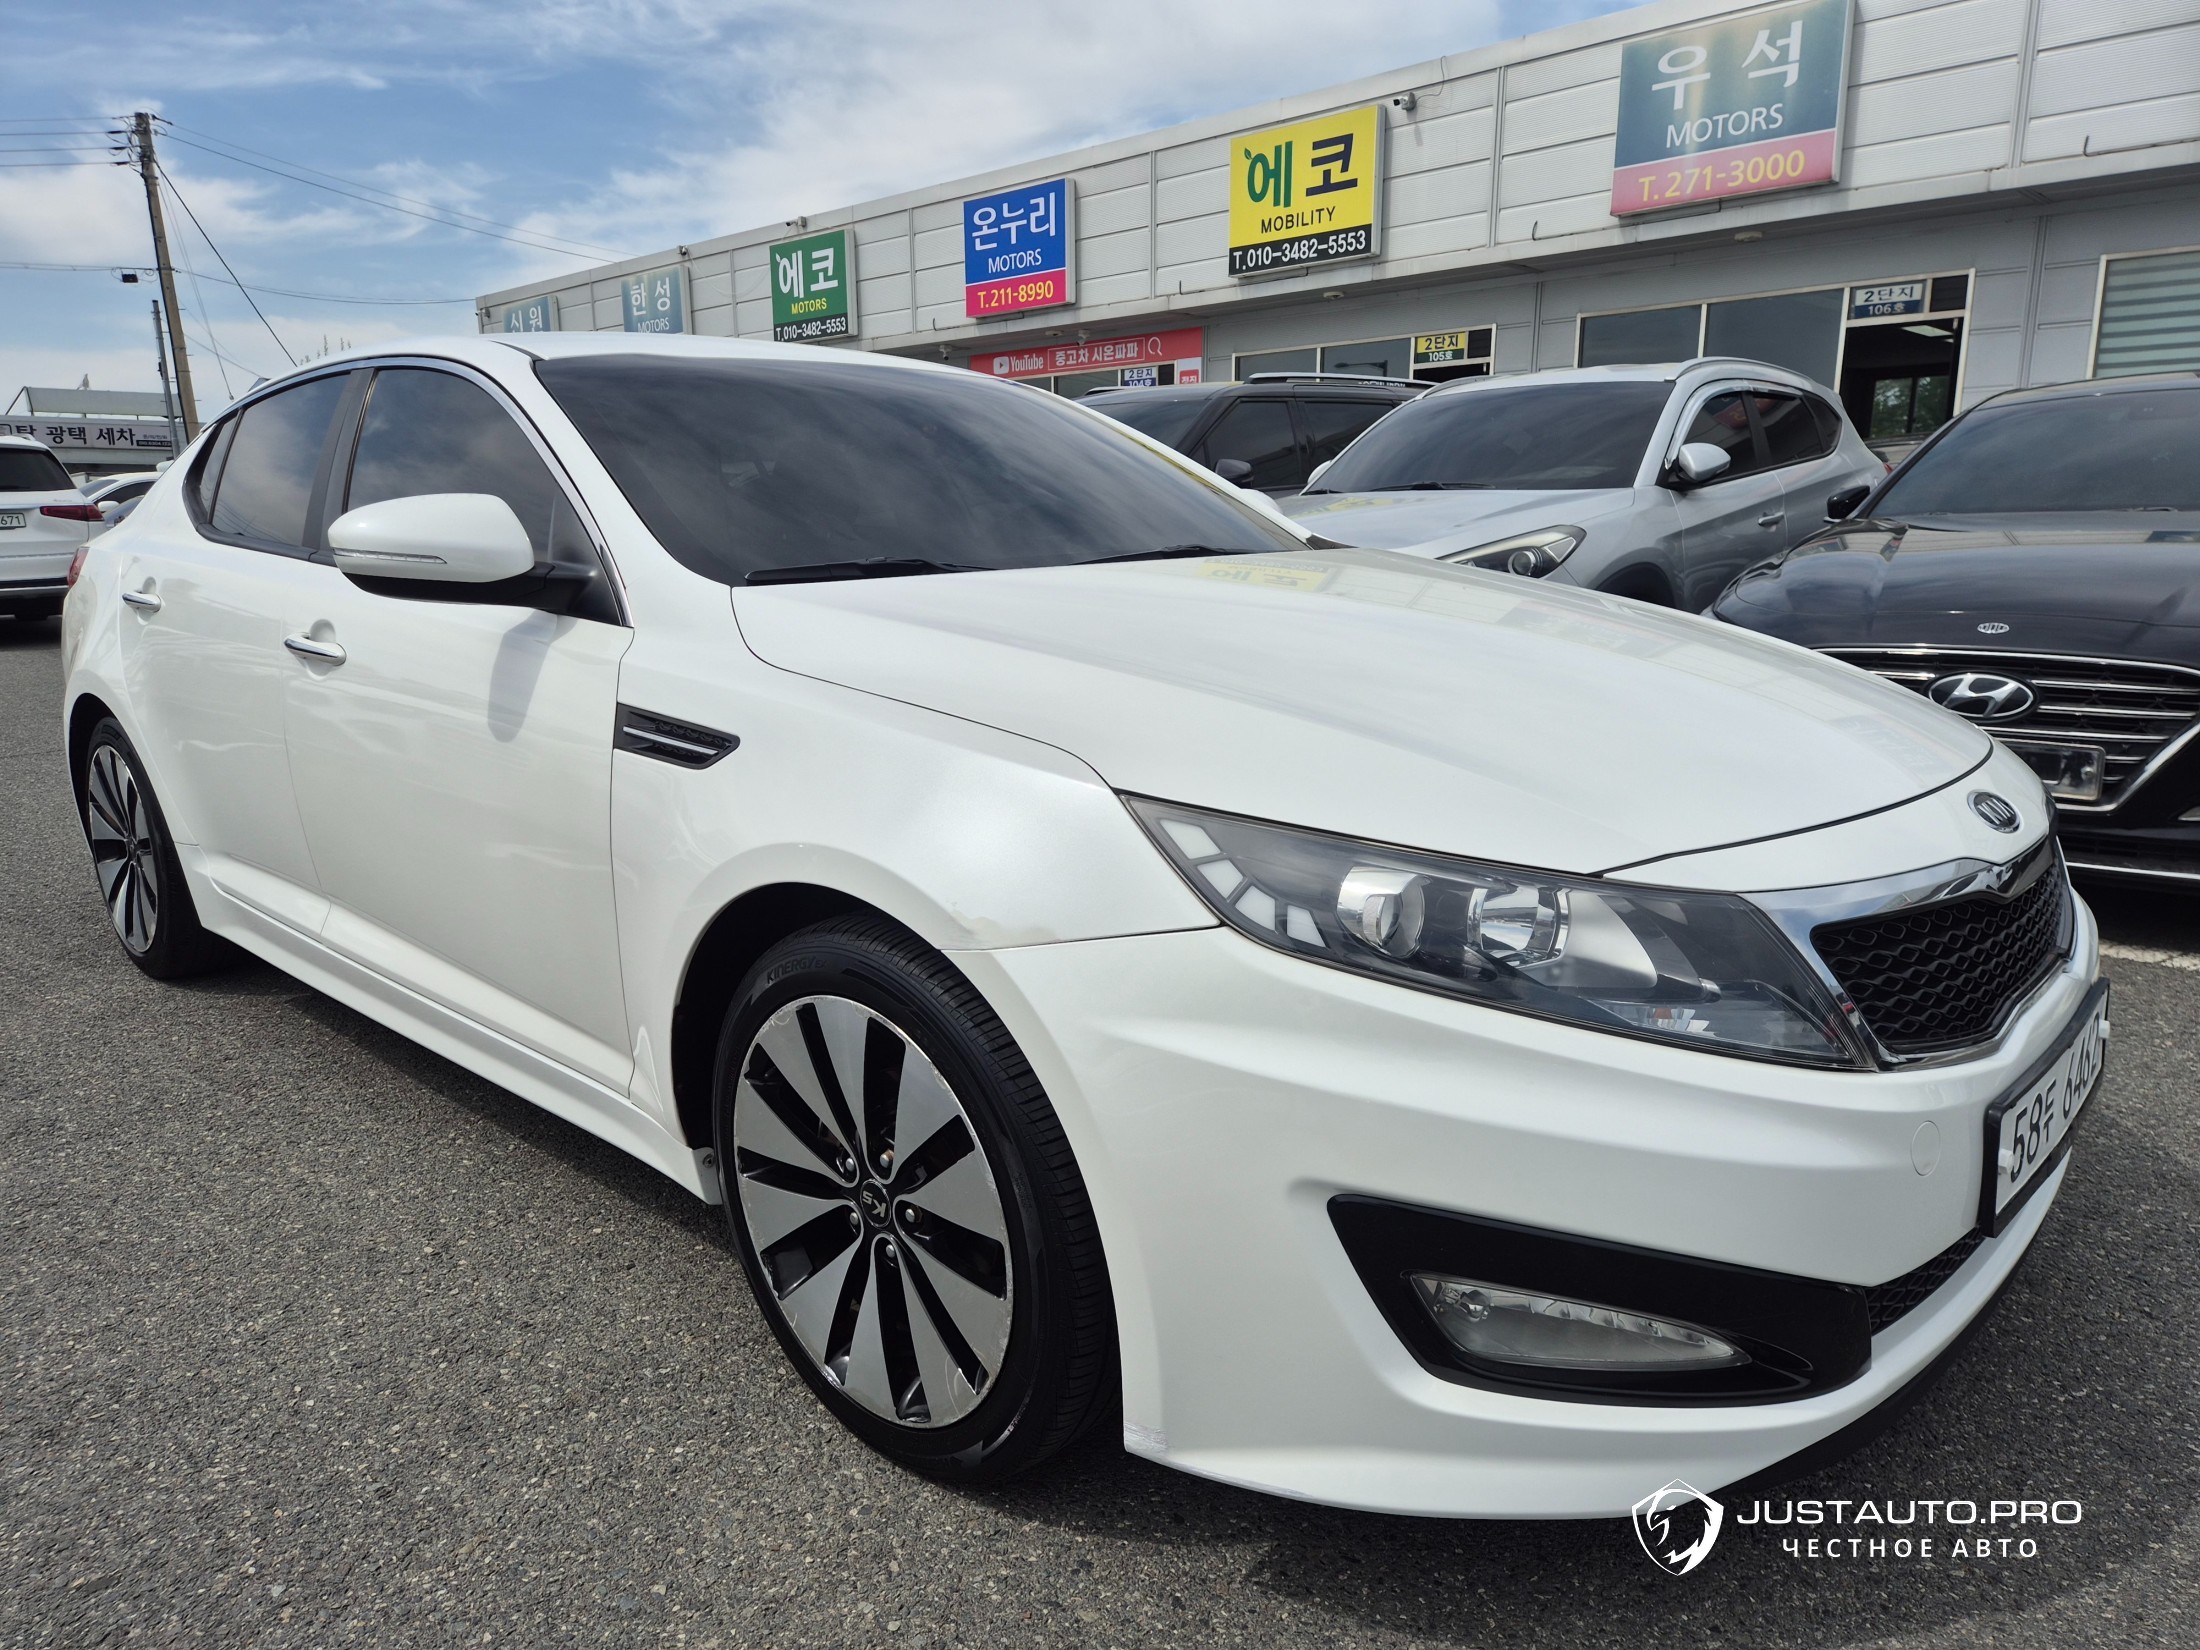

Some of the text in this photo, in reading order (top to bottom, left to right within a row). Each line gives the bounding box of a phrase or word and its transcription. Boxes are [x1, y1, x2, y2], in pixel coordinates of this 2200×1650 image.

[1652, 20, 1803, 110] 우석
[1666, 103, 1784, 148] MOTORS
[1244, 133, 1358, 208] 에코
[1638, 150, 1805, 201] T.271-3000
[972, 192, 1056, 250] 온누리
[1261, 206, 1336, 233] MOBILITY
[988, 248, 1042, 274] MOTORS
[1233, 230, 1366, 270] T.010-3482-5553
[775, 248, 838, 298] 에코
[631, 277, 671, 316] 한성
[791, 298, 827, 314] MOTORS
[977, 280, 1054, 308] T.211-8990
[1868, 302, 1906, 315] 106호
[637, 317, 669, 333] MOTORS
[776, 317, 846, 341] T.010-3482-5553
[1011, 342, 1138, 371] YouTube 중고차 시온파파
[1428, 351, 1453, 361] 105호
[46, 426, 87, 444] 광택
[96, 427, 135, 446] 세차
[2010, 1012, 2099, 1183] 58두 6462
[862, 1190, 887, 1218] K5
